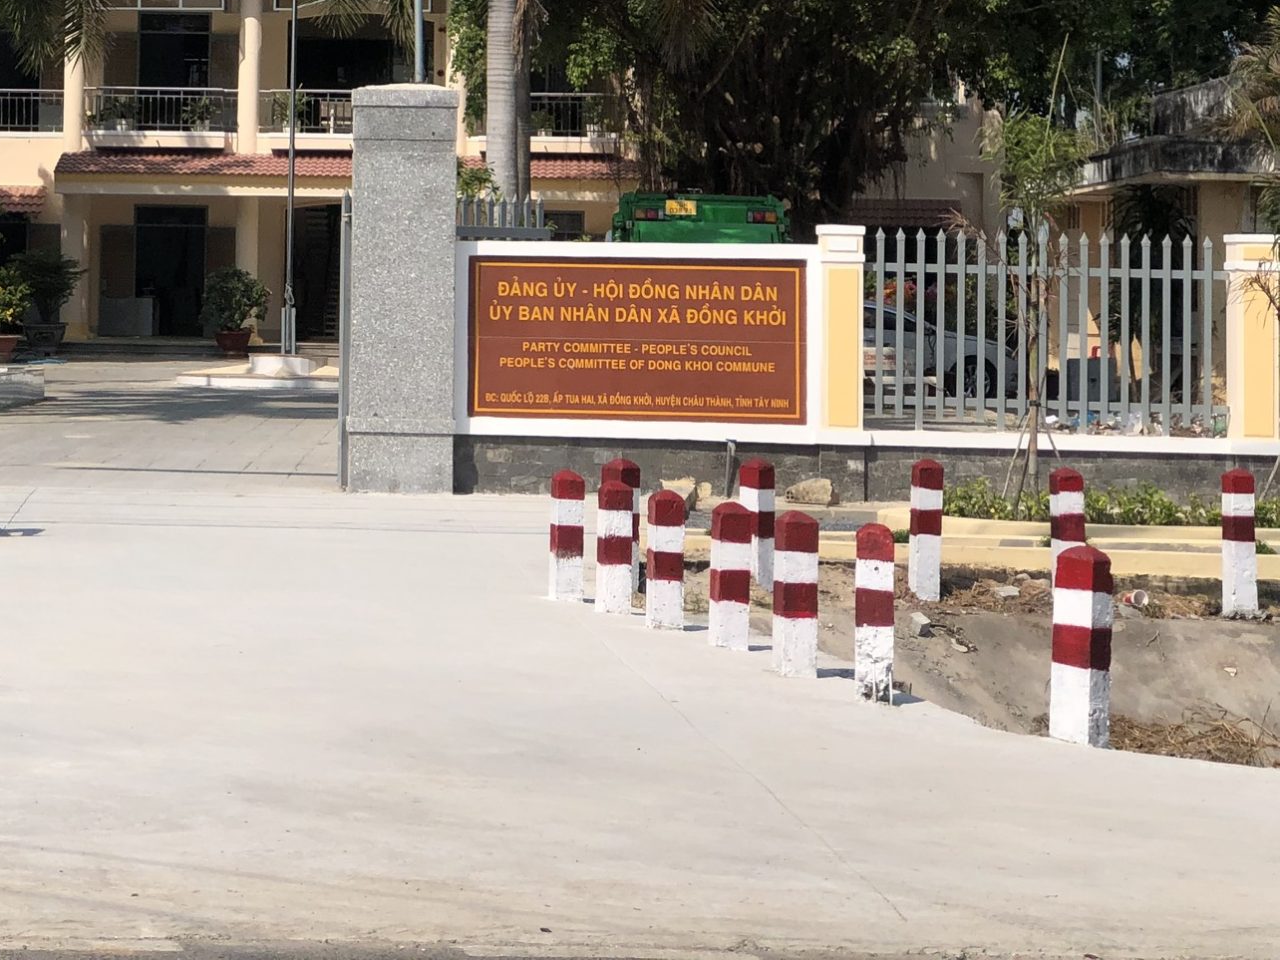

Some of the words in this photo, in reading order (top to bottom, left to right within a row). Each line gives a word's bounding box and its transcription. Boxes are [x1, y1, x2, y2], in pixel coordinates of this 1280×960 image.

[498, 275, 548, 297] ĐẢNG
[553, 276, 577, 298] ỦY
[593, 279, 623, 301] HỘI
[628, 278, 680, 300] ĐỒNG
[685, 281, 735, 300] NHÂN
[741, 281, 778, 301] DÂN
[489, 299, 513, 321] ỦY
[518, 305, 554, 321] BAN
[560, 303, 609, 322] NHÂN
[615, 304, 652, 323] DÂN
[657, 304, 681, 323] XÃ
[686, 303, 738, 325] ĐỒNG
[743, 304, 786, 326] KHỞI
[522, 341, 561, 352] PARTY
[563, 342, 631, 354] COMMITTEE
[641, 343, 698, 355] PEOPLE'S
[701, 345, 752, 356] COUNCIL
[499, 356, 556, 368] PEOPLE'S
[558, 358, 626, 371] COMMITTEE
[629, 359, 645, 370] OF
[648, 360, 682, 371] DONG
[684, 360, 713, 371] KHOI
[716, 362, 775, 373] COMMUNE
[500, 390, 522, 403] QUỐC
[535, 394, 551, 404] 22B,
[553, 390, 563, 404] ẤP
[565, 394, 579, 404] TUA
[581, 394, 595, 405] HAI,
[597, 392, 608, 405] XÃ
[655, 394, 681, 407] HUYỆN
[682, 395, 704, 407] CHÂU
[705, 395, 734, 408] THÀNH,
[753, 397, 769, 408] TÂY
[771, 398, 789, 409] NINH
